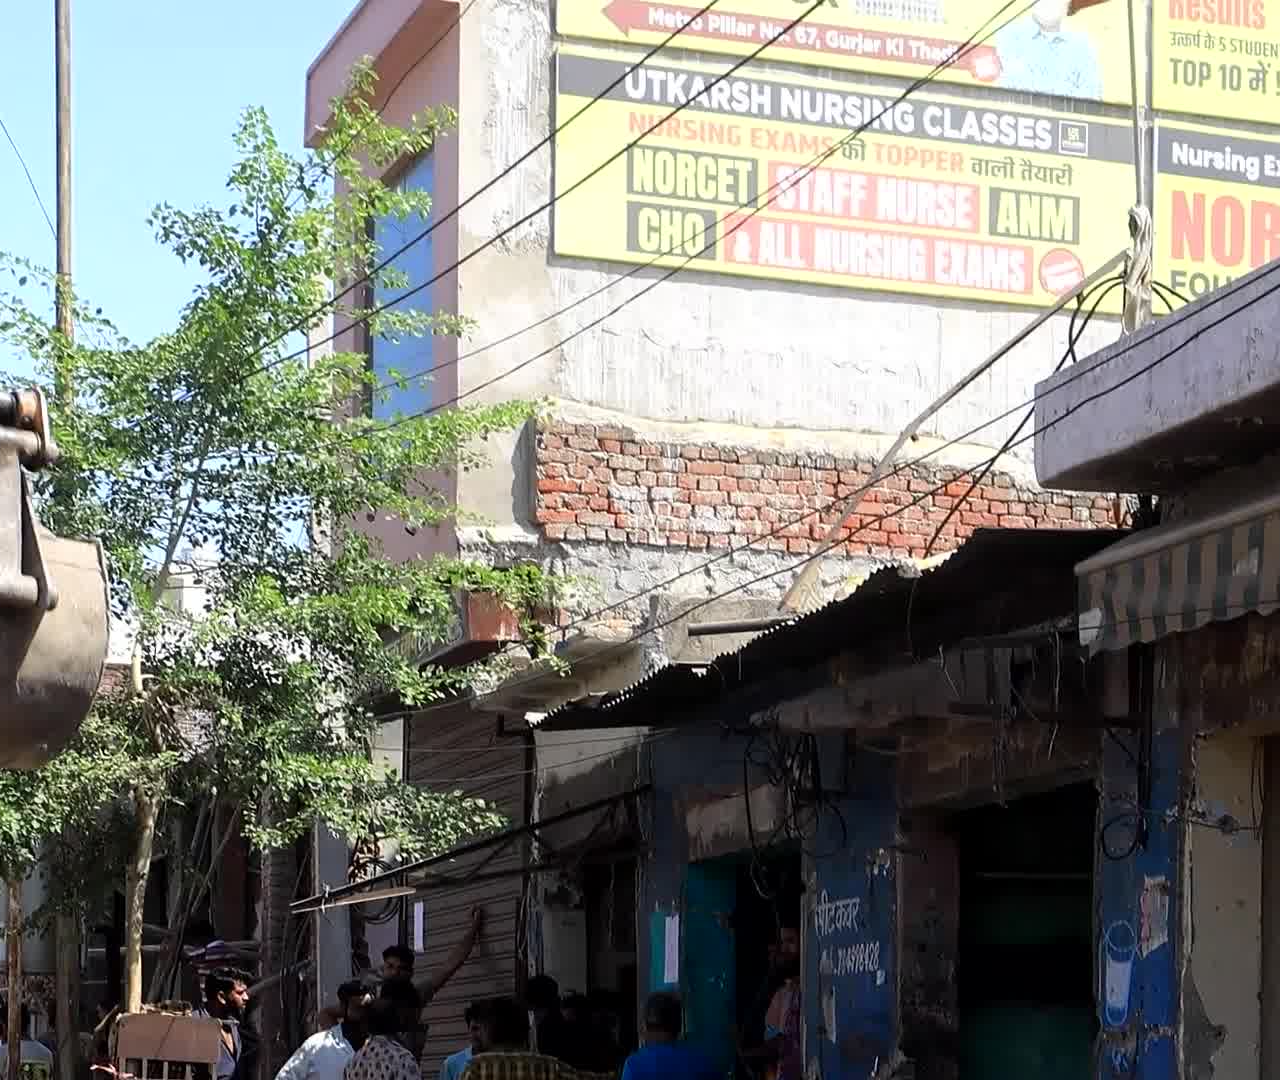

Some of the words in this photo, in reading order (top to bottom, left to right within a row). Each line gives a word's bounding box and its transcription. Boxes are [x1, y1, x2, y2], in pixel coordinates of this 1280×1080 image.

[648, 8, 703, 33] Metro
[708, 15, 755, 38] Pillar
[759, 21, 791, 41] No.
[825, 32, 881, 57] Gurjar
[886, 38, 905, 56] Ki
[1219, 36, 1227, 52] 5
[1169, 58, 1211, 88] TOP
[1219, 63, 1242, 92] 10
[624, 67, 771, 116] UTKARSH
[780, 85, 915, 133] NURSING
[922, 105, 1052, 150] CLASSES
[628, 112, 742, 147] NURSING
[750, 127, 834, 155] EXAMS
[872, 142, 964, 173] TOPPER
[971, 156, 1014, 180] वाली
[1020, 158, 1073, 187] तैयारी
[1172, 142, 1260, 181] Nursing
[632, 146, 752, 205] NORCET
[775, 165, 867, 218] STAFF
[876, 175, 972, 231] NURSE
[996, 189, 1074, 242] ANM
[637, 206, 706, 256] CHO
[759, 221, 806, 268] ALL
[814, 226, 928, 281] NURSING
[933, 239, 1025, 292] EXAMS
